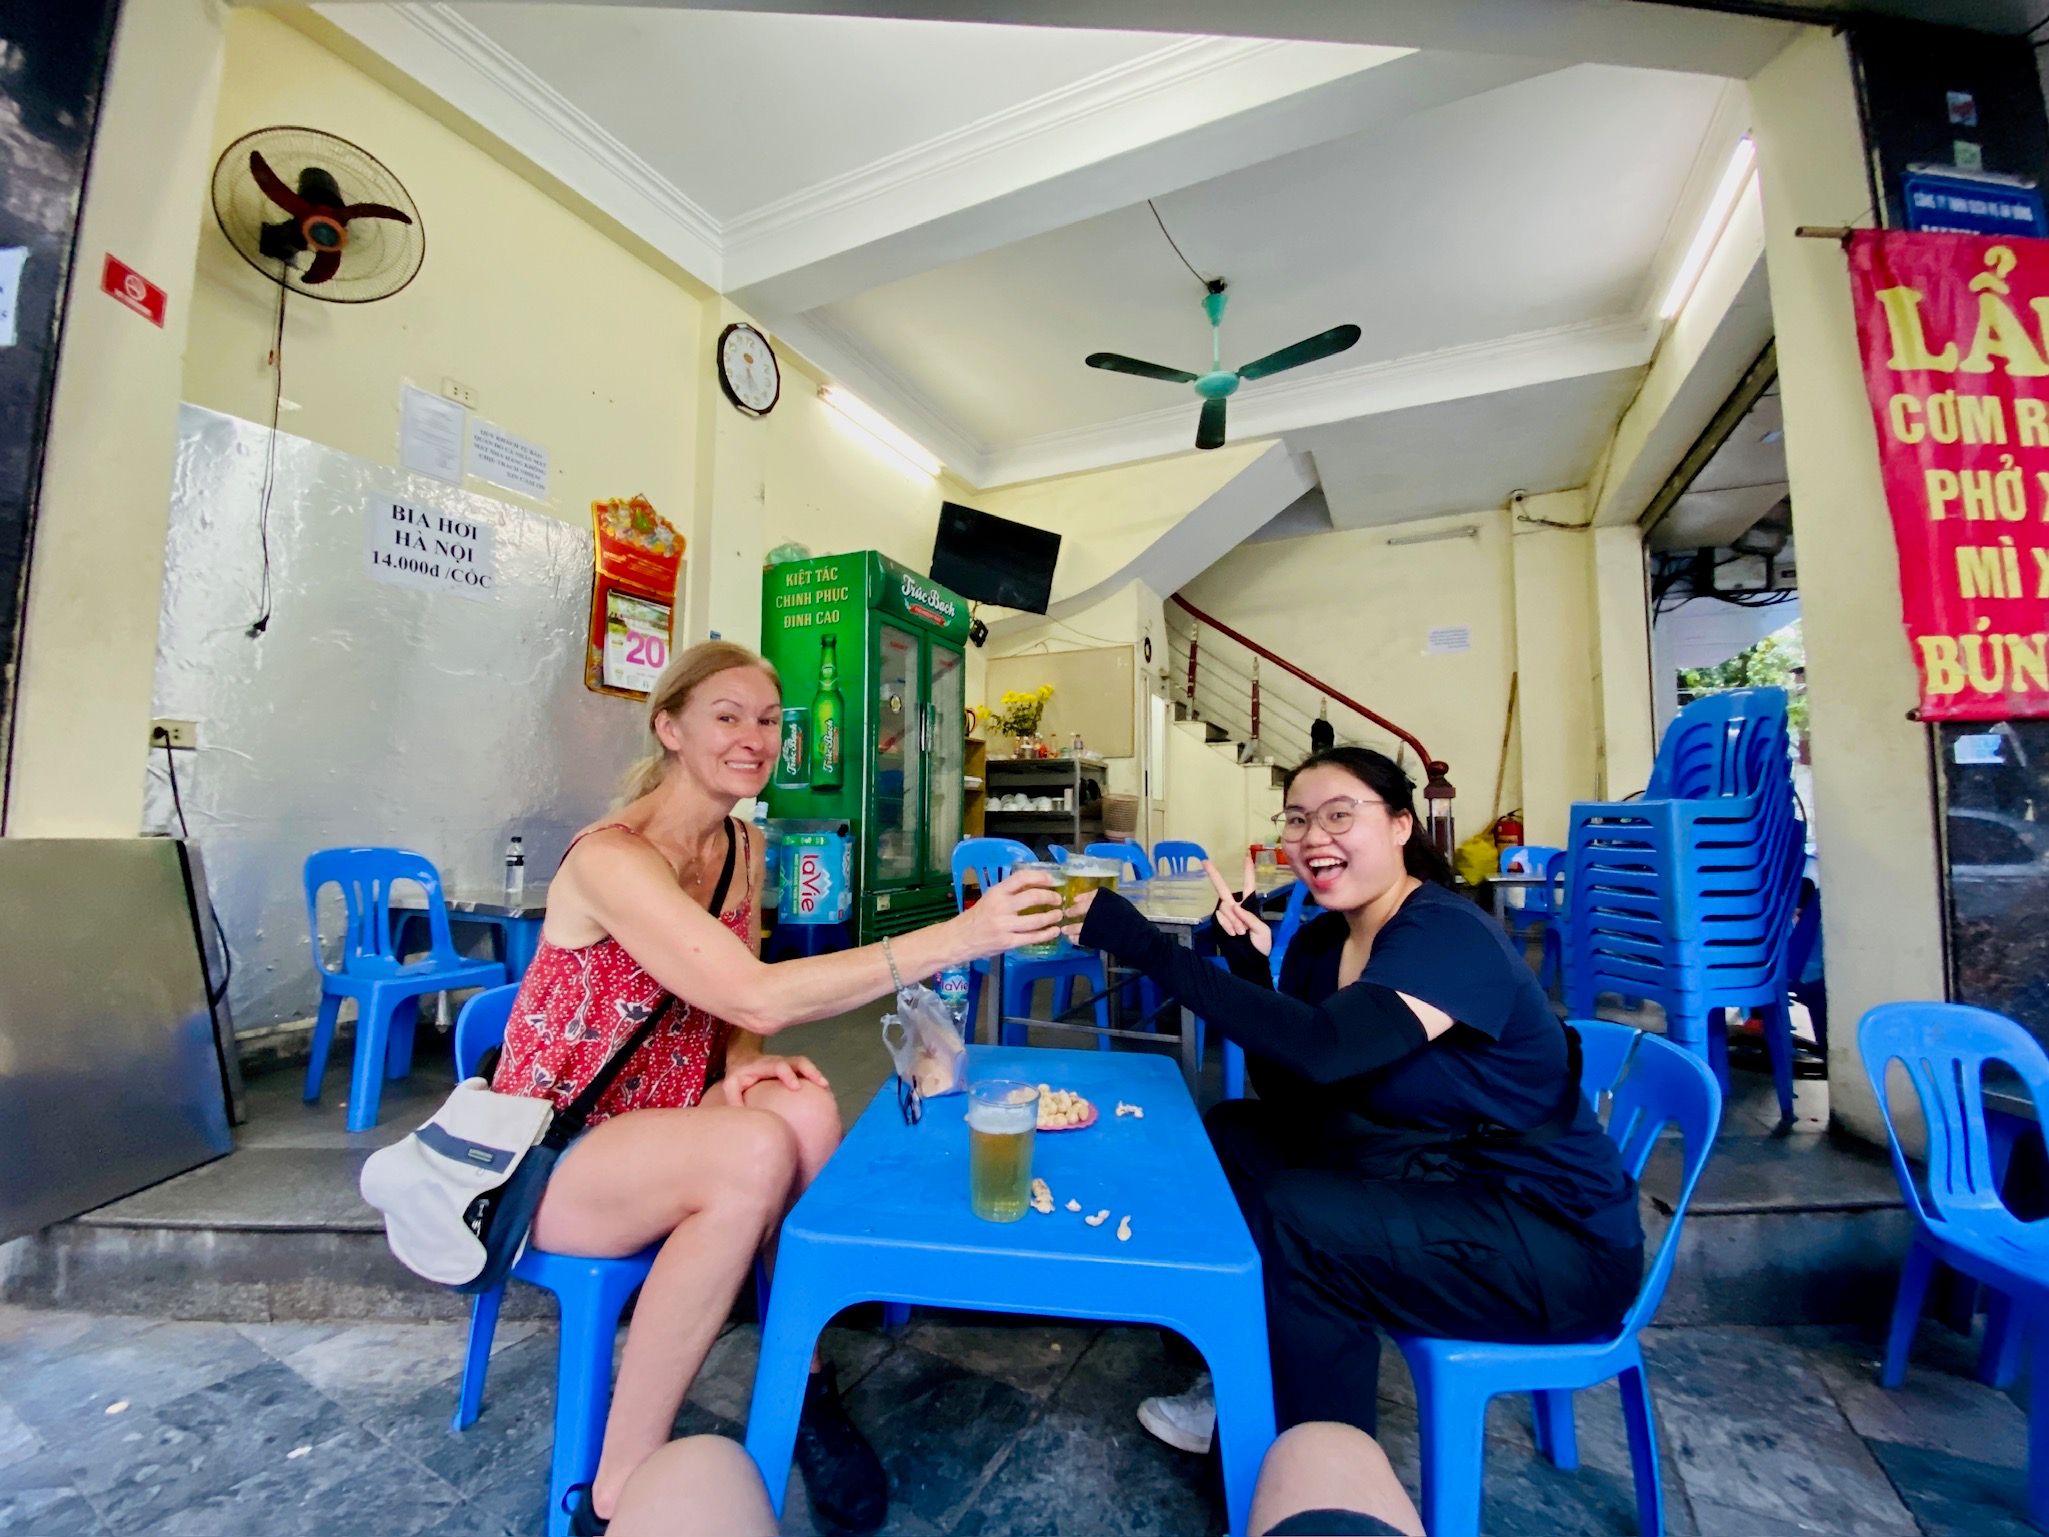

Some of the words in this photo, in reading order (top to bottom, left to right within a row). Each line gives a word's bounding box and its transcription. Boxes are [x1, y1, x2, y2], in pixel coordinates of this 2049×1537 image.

[1889, 389, 2008, 445] CƠM
[1925, 454, 2027, 522] PHỞ
[392, 503, 431, 529] BIA
[439, 517, 477, 541] HƠI
[372, 549, 440, 578] 14.000đ
[395, 529, 427, 552] HÀ
[434, 539, 473, 564] NỘI
[786, 568, 812, 588] KIỆT
[815, 565, 839, 582] TÁC
[1955, 536, 2024, 599] MÌ
[776, 591, 812, 609] CHINH
[815, 586, 849, 604] PHỤC
[816, 609, 840, 625] CAO
[625, 629, 666, 669] 20
[1915, 616, 2049, 695] BÚN
[801, 854, 822, 913] laVie
